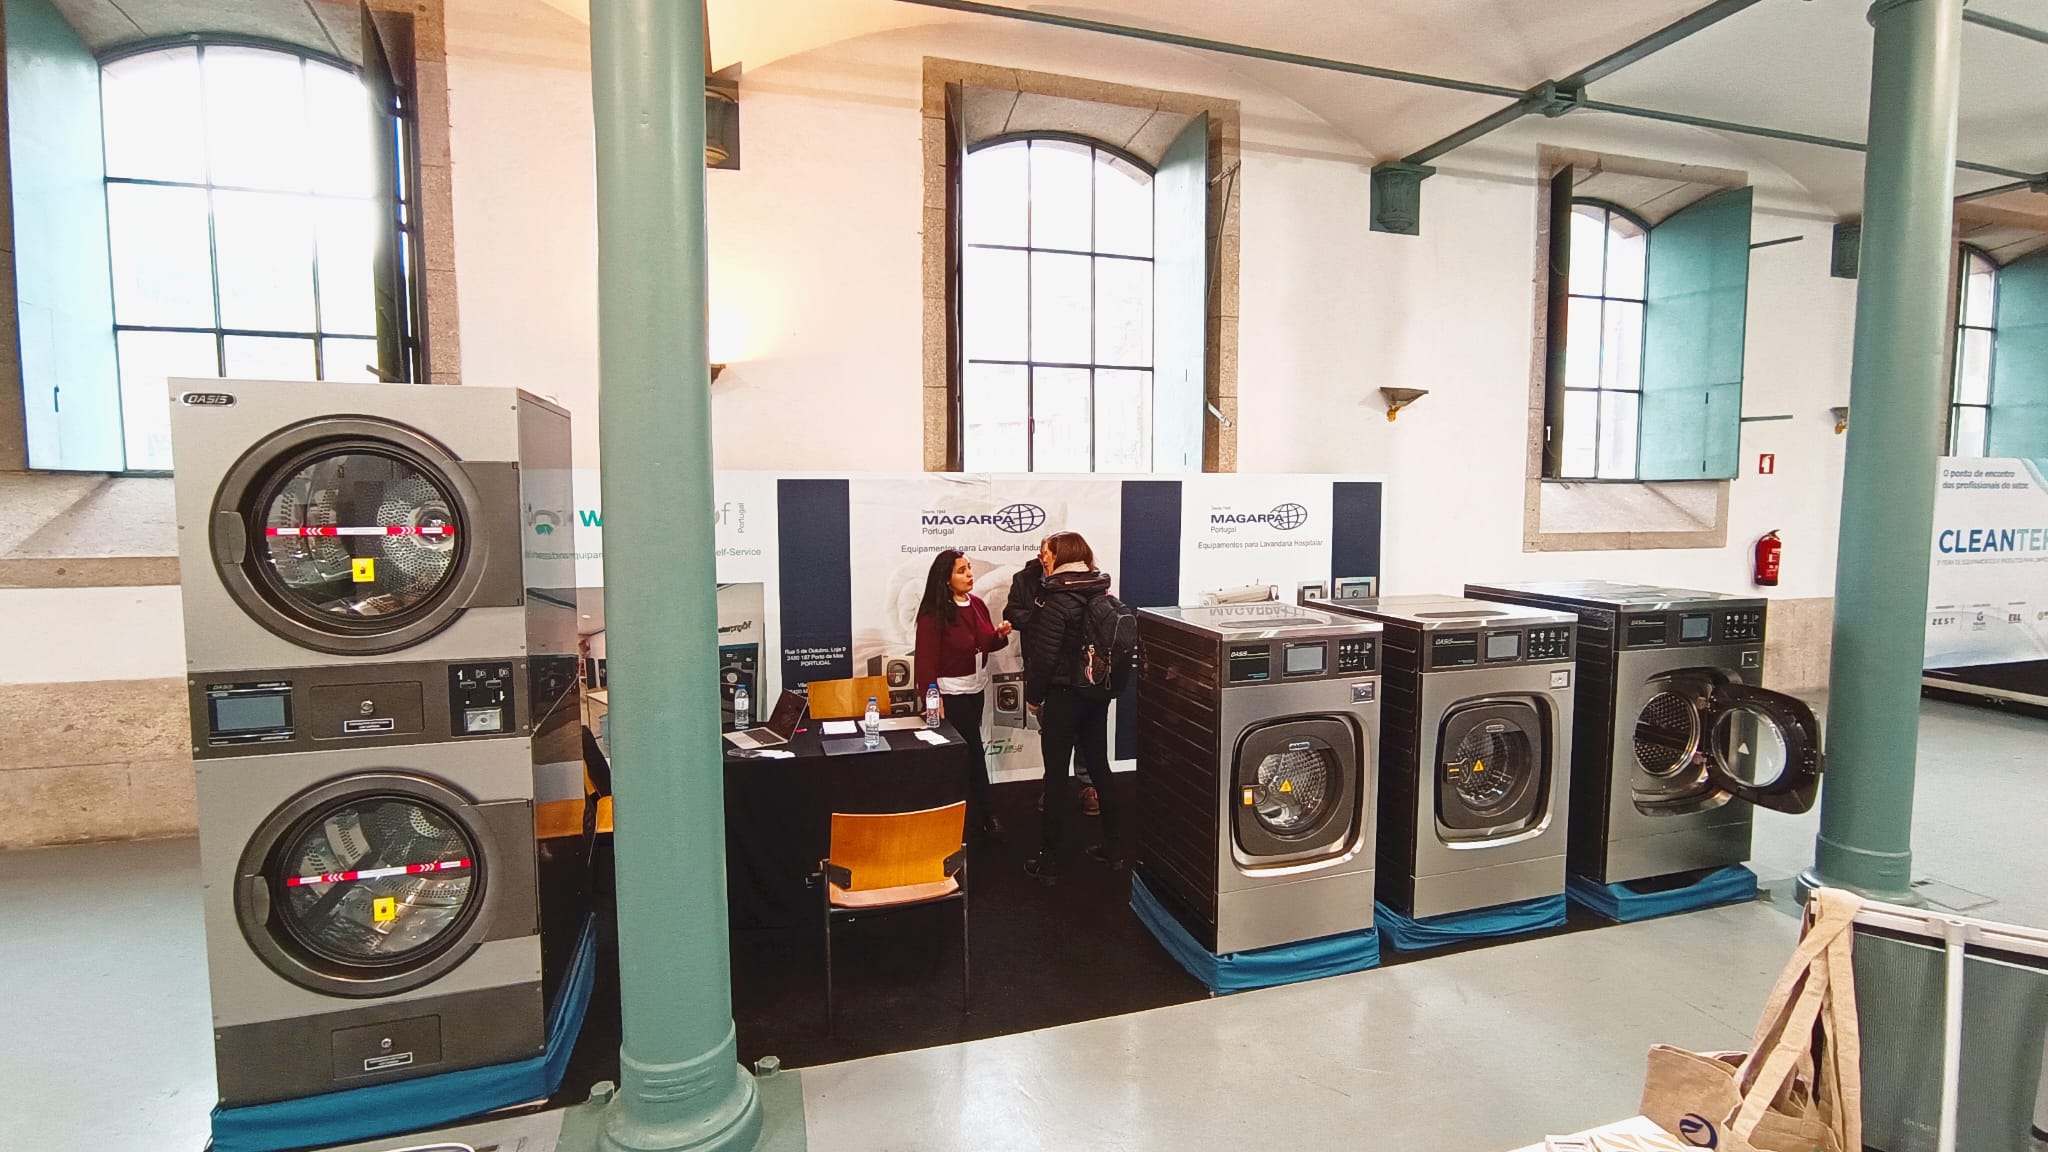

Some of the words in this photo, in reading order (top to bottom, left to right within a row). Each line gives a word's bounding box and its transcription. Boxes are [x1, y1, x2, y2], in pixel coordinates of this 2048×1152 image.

[921, 514, 1015, 525] MAGARPA
[1210, 514, 1285, 524] MAGARPA
[922, 527, 955, 536] Portugal
[1210, 526, 1237, 534] Portugal
[978, 543, 1021, 552] Lavandaria
[1198, 541, 1244, 550] Equipamentos
[1245, 541, 1259, 549] para
